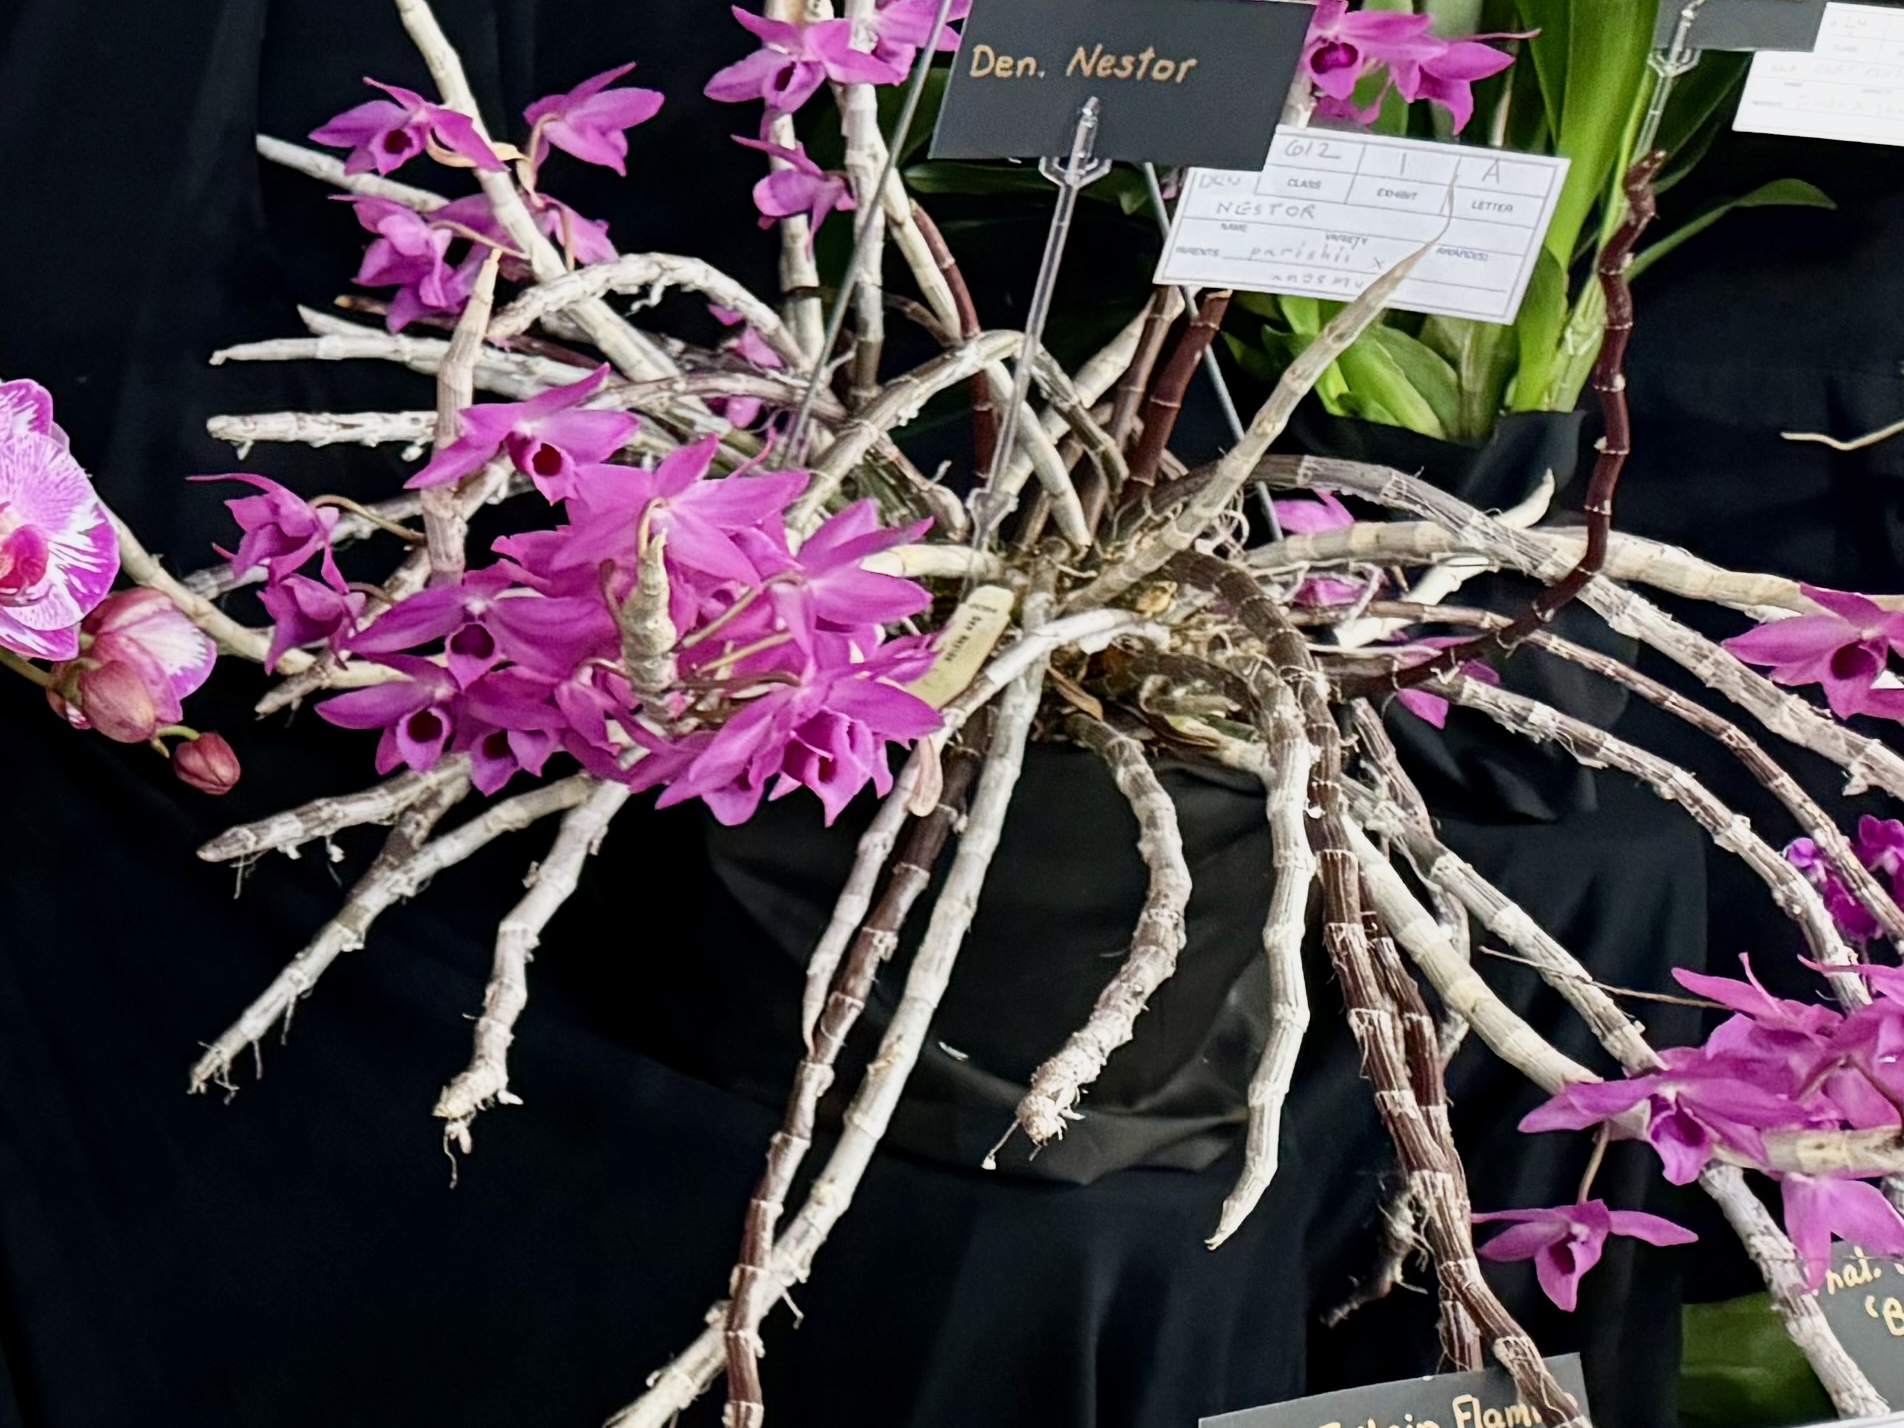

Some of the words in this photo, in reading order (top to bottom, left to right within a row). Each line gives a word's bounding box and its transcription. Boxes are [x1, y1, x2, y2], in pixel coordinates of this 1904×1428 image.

[970, 44, 1045, 79] Den.
[1065, 44, 1198, 83] Nestor
[1284, 141, 1342, 160] 612
[1216, 200, 1315, 220] NESTOR
[1471, 200, 1514, 214] LETTER
[1803, 1245, 1882, 1296] hal.
